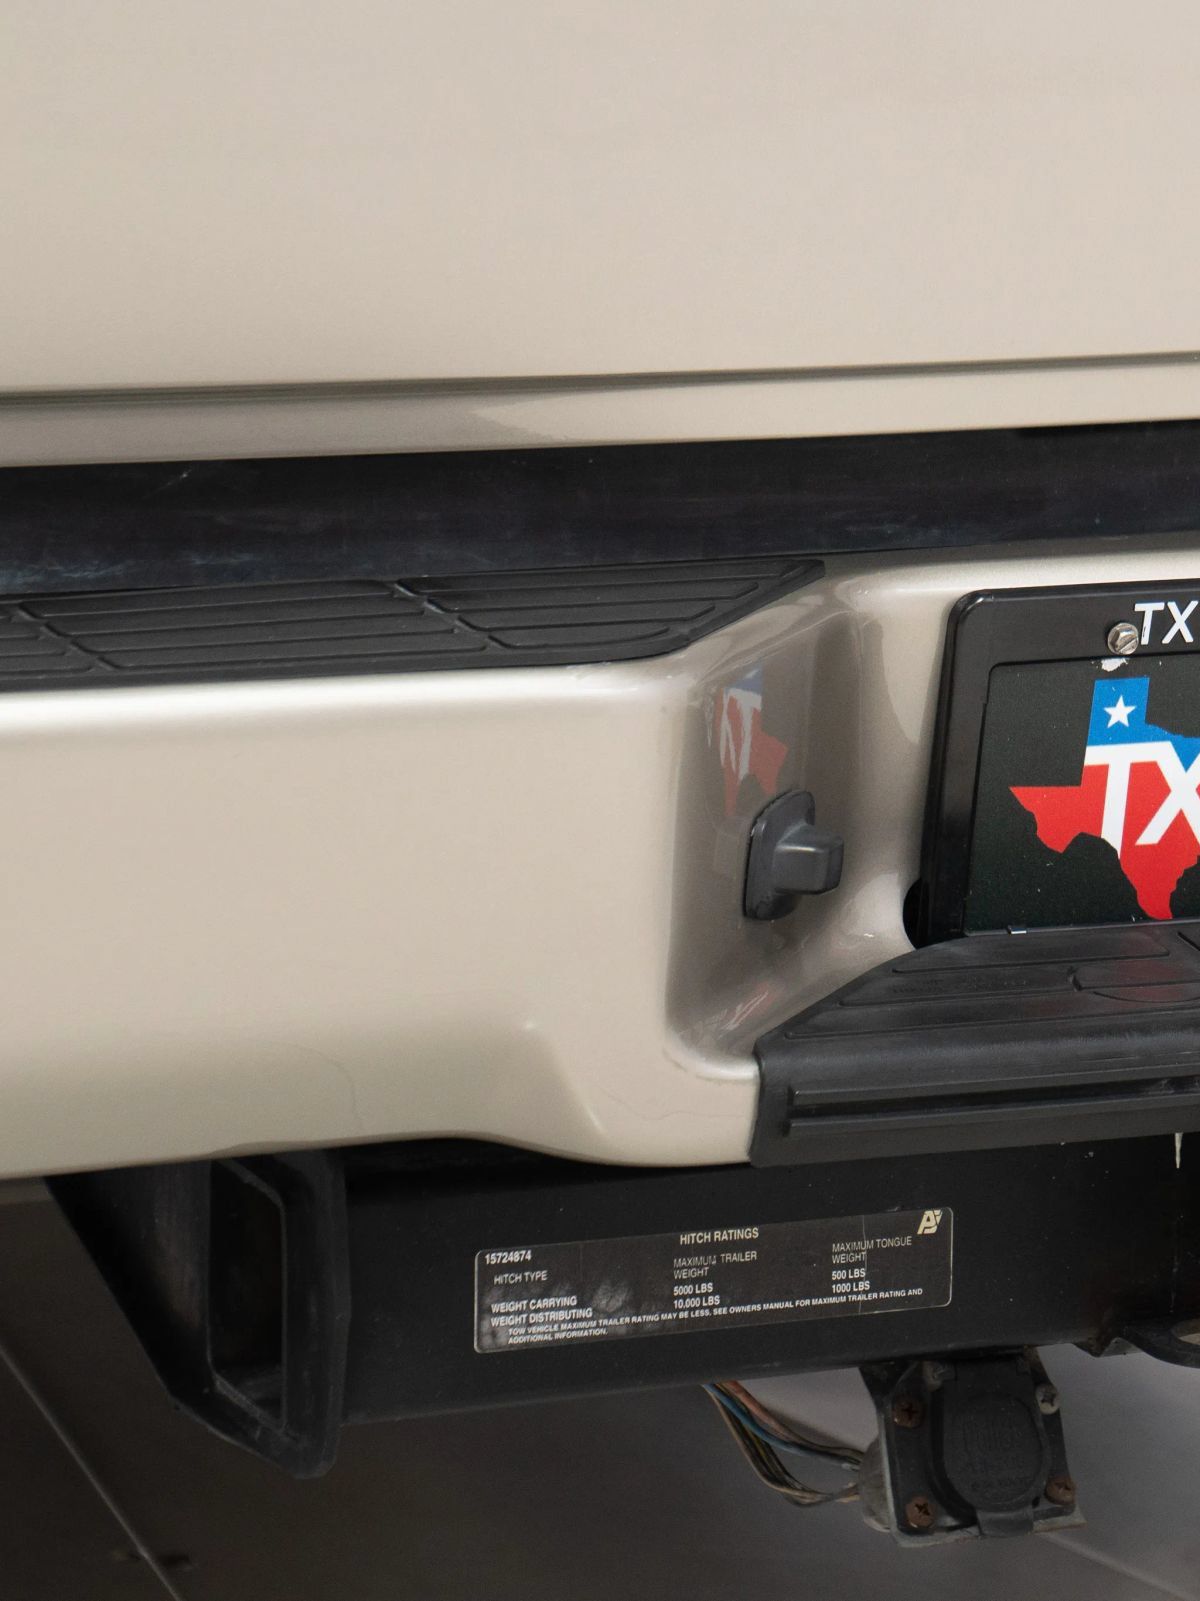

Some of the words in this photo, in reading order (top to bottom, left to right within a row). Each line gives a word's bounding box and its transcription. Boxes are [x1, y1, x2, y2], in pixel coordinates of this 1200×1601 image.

[1133, 600, 1200, 647] TX
[680, 1231, 712, 1245] HITCH
[714, 1227, 759, 1242] RATINGS
[832, 1238, 874, 1252] MAXIMUM
[876, 1236, 912, 1249] TONGUE
[673, 1255, 717, 1268] MAXIMUM
[720, 1250, 758, 1263] TRAILER
[832, 1252, 866, 1264] WEIGHT
[493, 1272, 522, 1284] HITCH
[523, 1270, 548, 1282] TYPE
[673, 1266, 709, 1279] WEIGHT
[832, 1269, 847, 1280] 500
[848, 1268, 866, 1279] LBS
[673, 1283, 693, 1296] 5000
[695, 1282, 713, 1294] LBS
[832, 1282, 851, 1293] 1000
[852, 1281, 870, 1292] LBS
[491, 1300, 527, 1313] WEIGHT
[529, 1296, 578, 1310] CARRYING
[702, 1295, 720, 1306] LBS
[490, 1313, 527, 1327] WEIGHT
[529, 1308, 593, 1324] DISTRIBUTING
[508, 1327, 526, 1336] TOW
[527, 1324, 559, 1334] VEHICLE
[561, 1321, 597, 1331] MAXIMUM
[599, 1317, 630, 1327] TRAILER
[631, 1314, 660, 1323] RATING
[661, 1311, 678, 1320] MAY
[679, 1310, 690, 1318] BE
[713, 1305, 728, 1315] SEE
[729, 1302, 762, 1314] OWNERS
[763, 1300, 794, 1311] MANUAL
[795, 1299, 811, 1308] FOR
[812, 1296, 847, 1306] MAXIMUM
[848, 1292, 878, 1302] TRAILER
[879, 1290, 906, 1299] RATING
[907, 1287, 923, 1296] AND
[508, 1333, 553, 1344] ADDITIONAL
